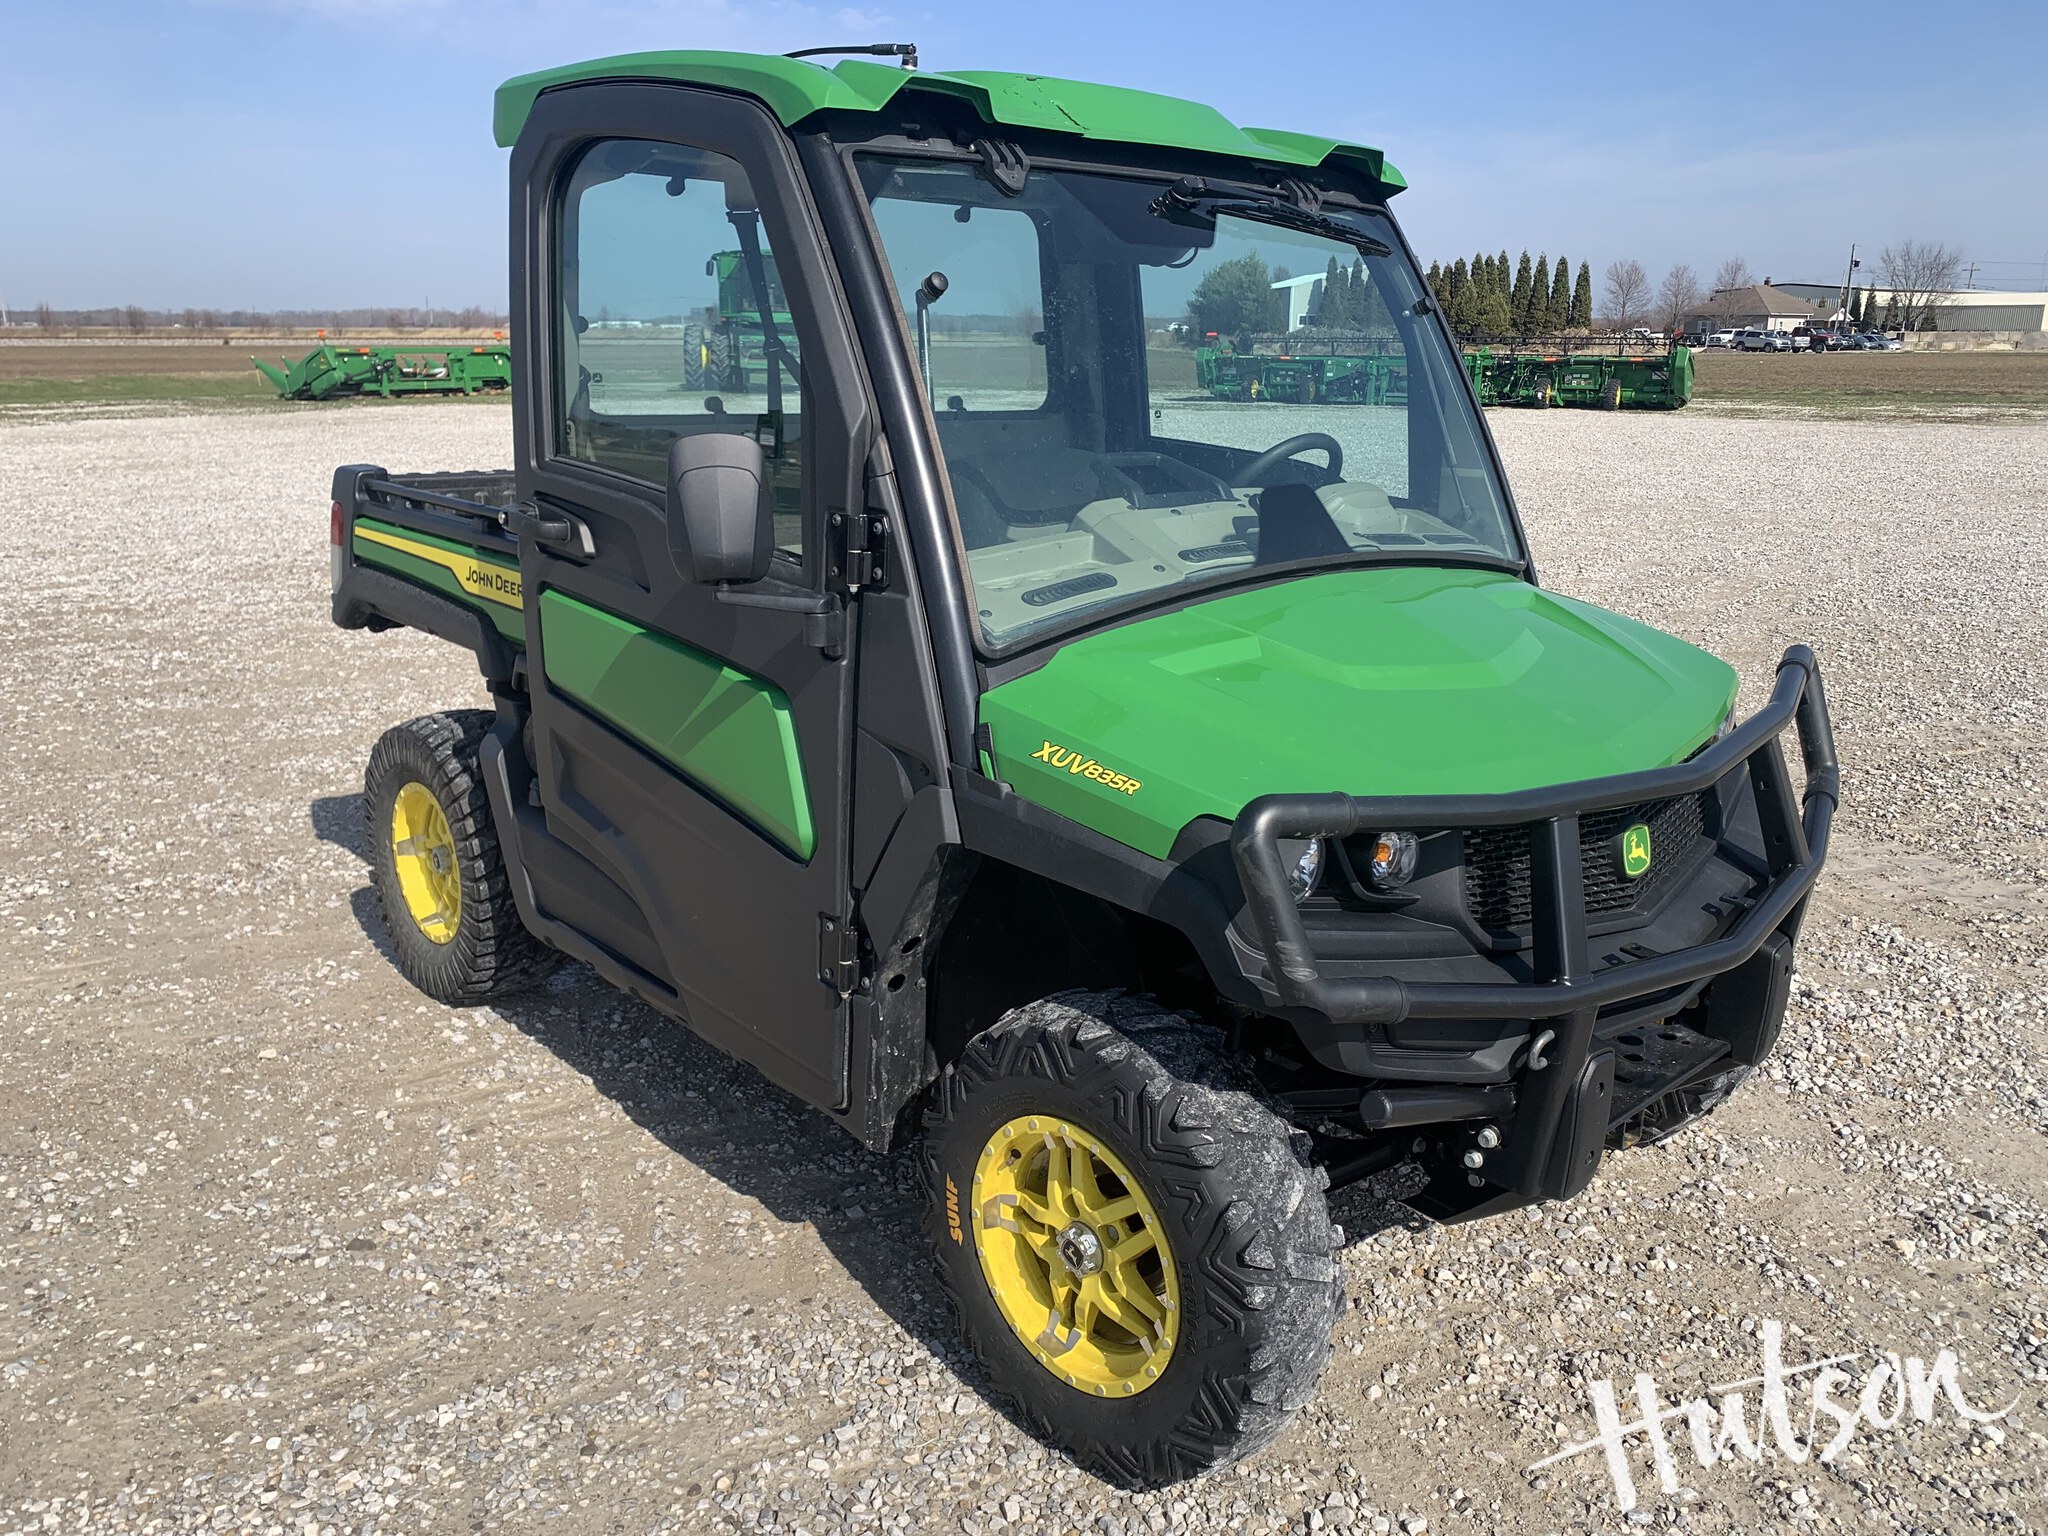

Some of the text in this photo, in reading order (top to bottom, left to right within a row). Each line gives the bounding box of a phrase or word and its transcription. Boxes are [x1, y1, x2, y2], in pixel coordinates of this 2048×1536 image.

[466, 565, 493, 589] JOHN
[1028, 739, 1143, 796] XUV835R
[946, 1172, 964, 1247] SUNF
